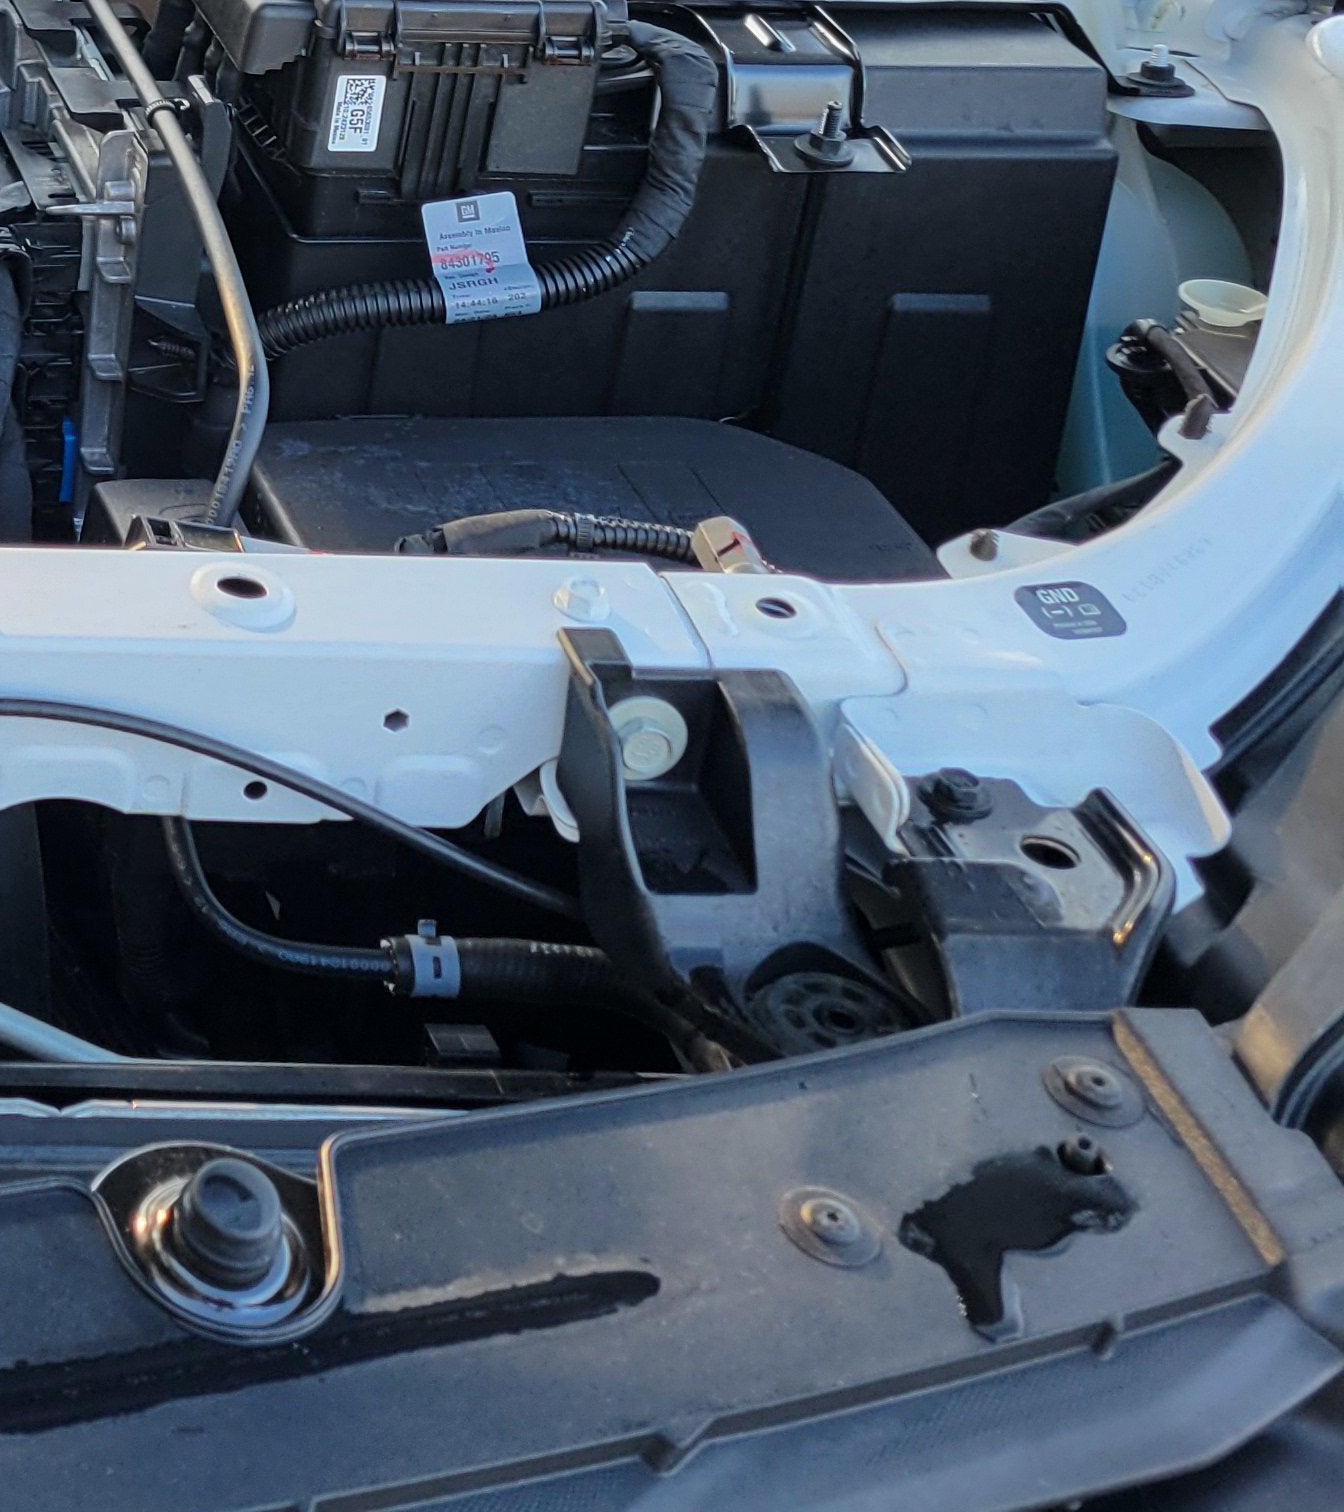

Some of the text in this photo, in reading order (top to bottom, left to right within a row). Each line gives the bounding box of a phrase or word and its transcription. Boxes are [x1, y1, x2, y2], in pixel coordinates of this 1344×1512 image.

[348, 108, 365, 134] G5F
[440, 251, 500, 271] 84301795
[1036, 588, 1079, 604] GND
